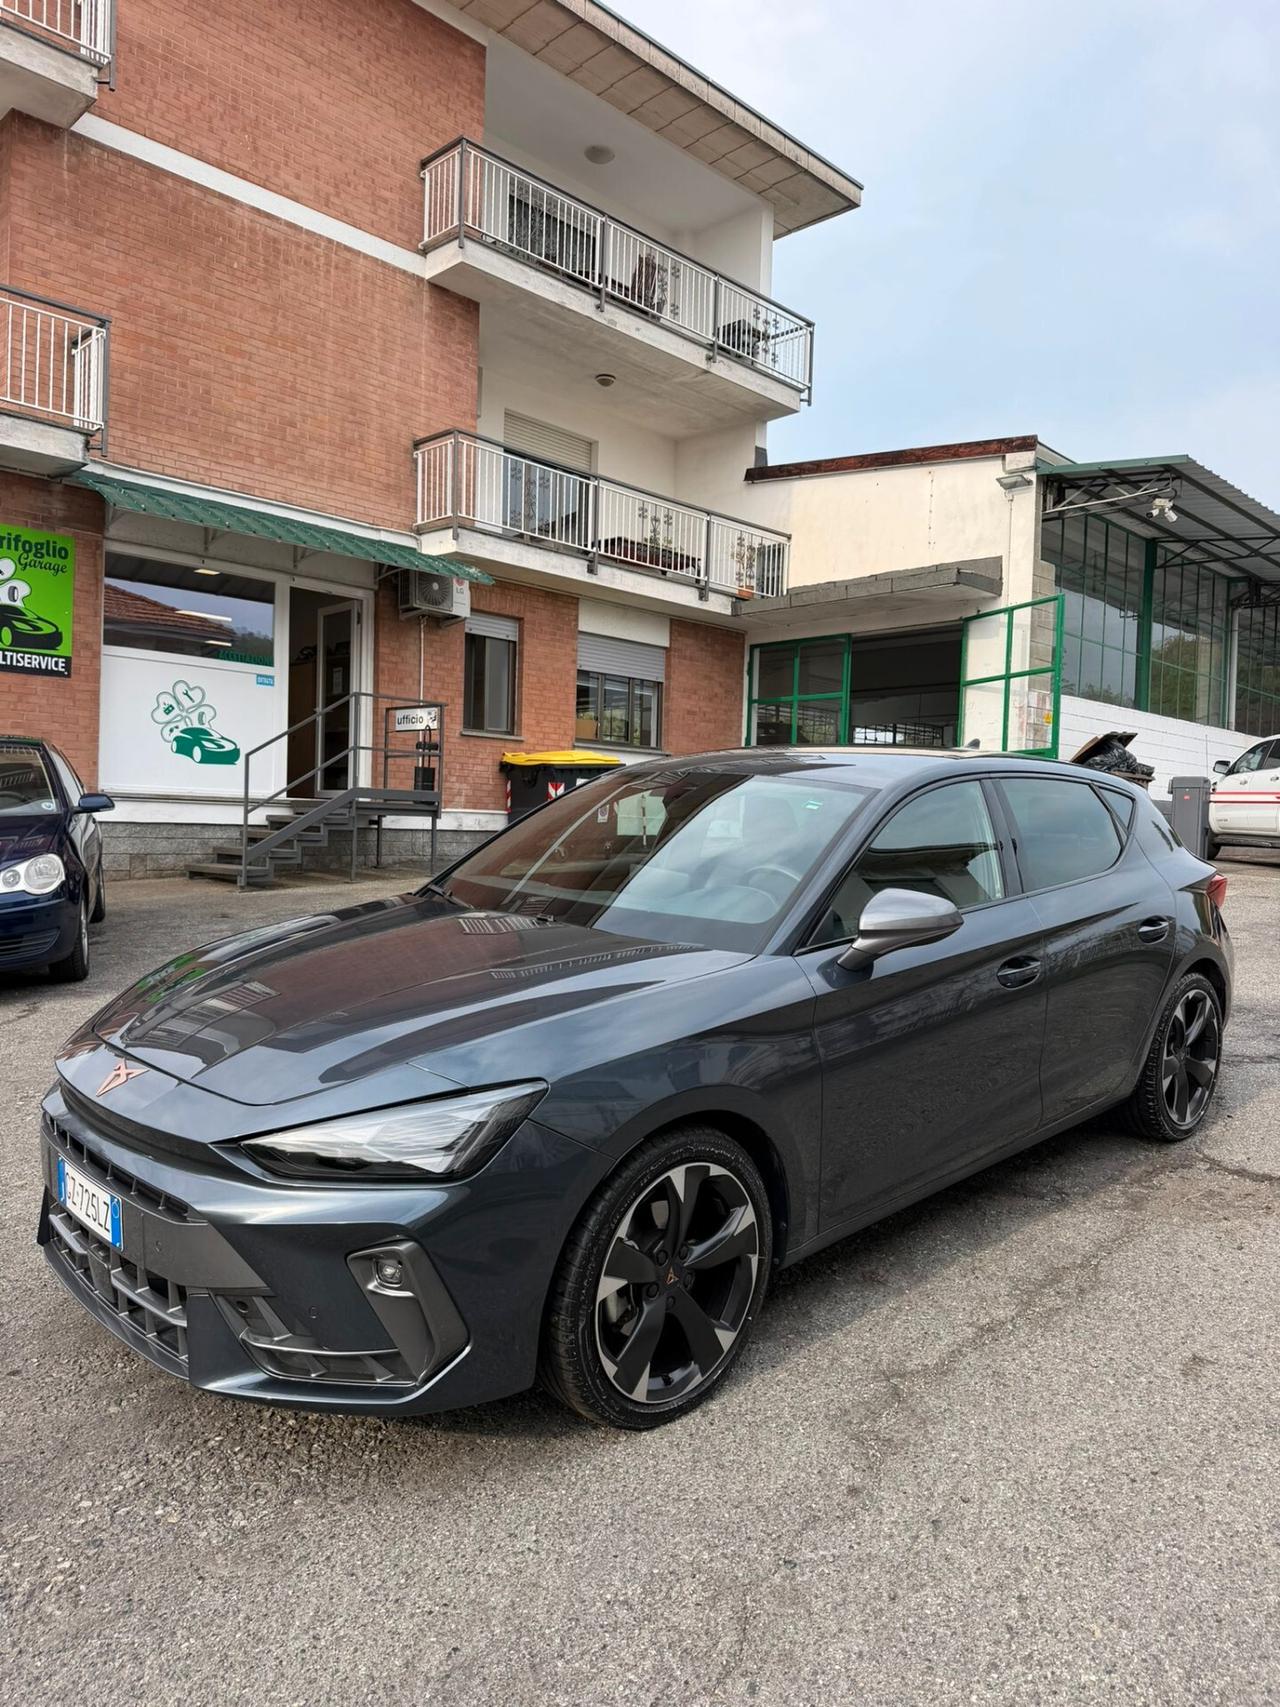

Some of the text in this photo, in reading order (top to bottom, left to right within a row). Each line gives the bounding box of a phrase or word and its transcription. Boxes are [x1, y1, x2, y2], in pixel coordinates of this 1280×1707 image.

[0, 532, 69, 560] rifoglio
[18, 551, 68, 576] Garage
[456, 586, 465, 595] LG
[0, 650, 66, 672] LTISERVICE
[397, 713, 424, 725] ufficio
